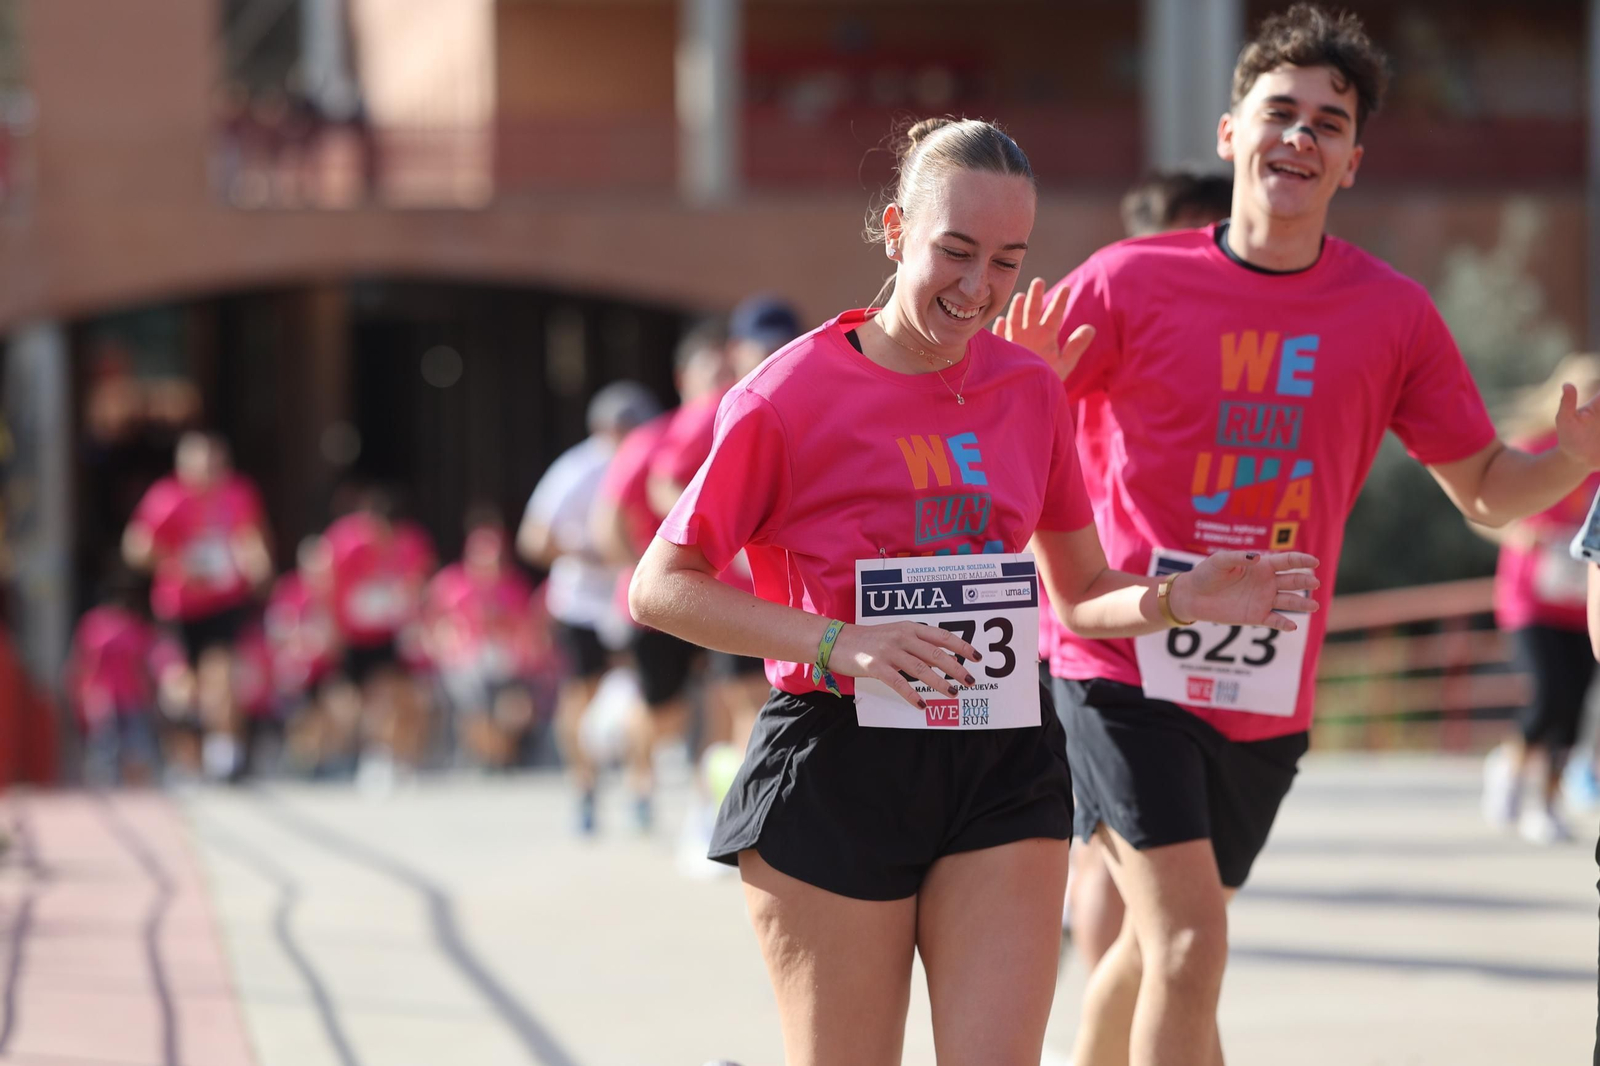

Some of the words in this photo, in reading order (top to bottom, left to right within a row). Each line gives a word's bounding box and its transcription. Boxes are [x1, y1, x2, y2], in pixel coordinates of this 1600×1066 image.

[1220, 330, 1320, 397] WE
[1223, 404, 1299, 446] RUN
[896, 432, 988, 490] WE
[1191, 452, 1314, 519] UMA
[920, 497, 987, 539] RUN
[906, 566, 936, 574] CARRERA
[907, 573, 957, 583] UNIVERSIDAD
[969, 571, 998, 579] MÁLAGA
[867, 587, 951, 611] UMA
[1005, 587, 1030, 597] uma.es
[1166, 624, 1280, 667] 623
[926, 705, 959, 720] WE
[962, 698, 989, 708] RUN
[962, 716, 989, 726] RUN
